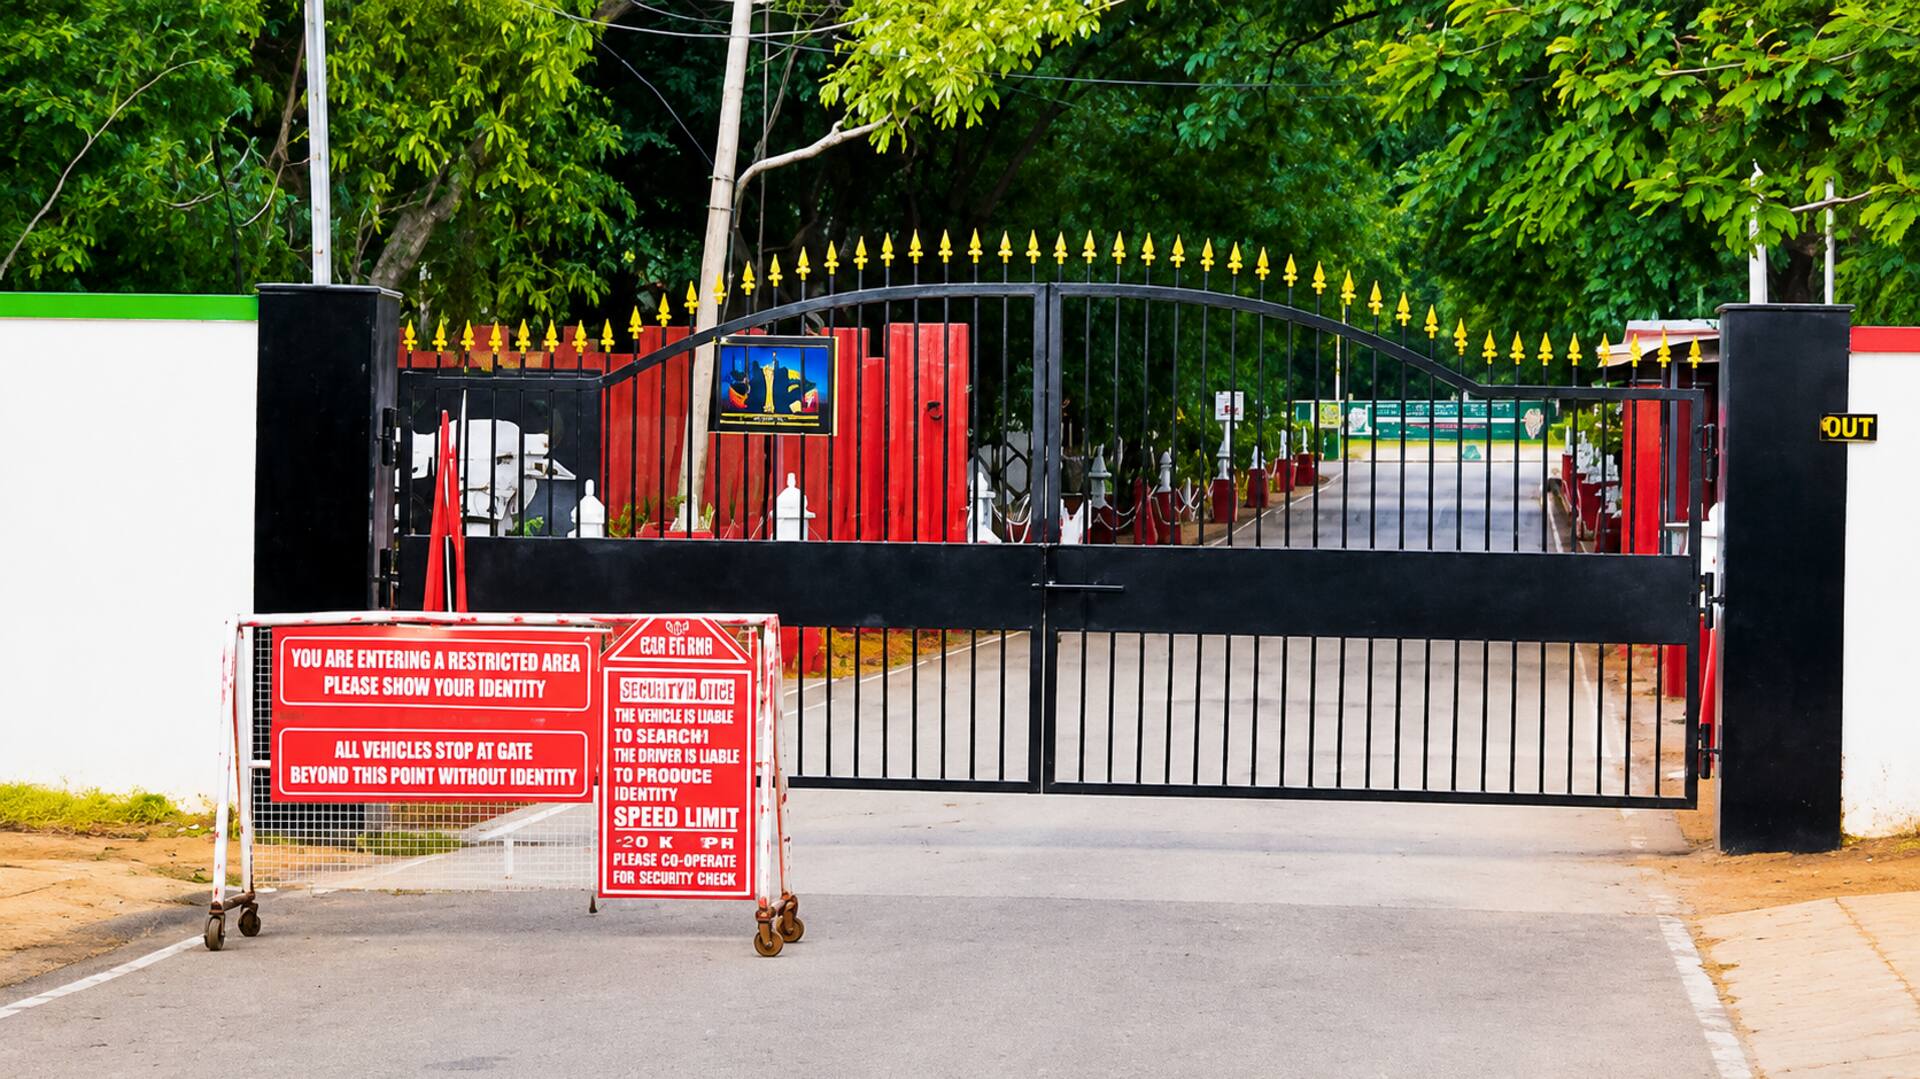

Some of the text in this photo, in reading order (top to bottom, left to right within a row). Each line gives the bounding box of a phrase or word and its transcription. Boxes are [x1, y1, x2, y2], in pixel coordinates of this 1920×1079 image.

[1827, 416, 1874, 438] OUT
[292, 649, 580, 672] YOU ARE ENTERING A RESTRICTED AREA
[325, 676, 545, 698] PLEASE SHOW YOUR IDENTITY
[615, 708, 733, 724] THE VEHICLE IS LIABLE
[615, 728, 632, 743] TO
[335, 741, 532, 760] ALL VEHICLES STOP AT GATE
[614, 748, 739, 763] THE DRIVER IS LIABLE
[291, 766, 576, 785] BEYOND THIS POINT WITHOUT IDENTITY
[614, 768, 711, 783] TO PRODUCE
[615, 787, 677, 801] IDENTITY
[614, 807, 739, 828] SPEED LIMIT
[614, 853, 736, 867] PLEASE CO-OPERATE
[614, 871, 735, 885] FOR SECURITY CHECK
